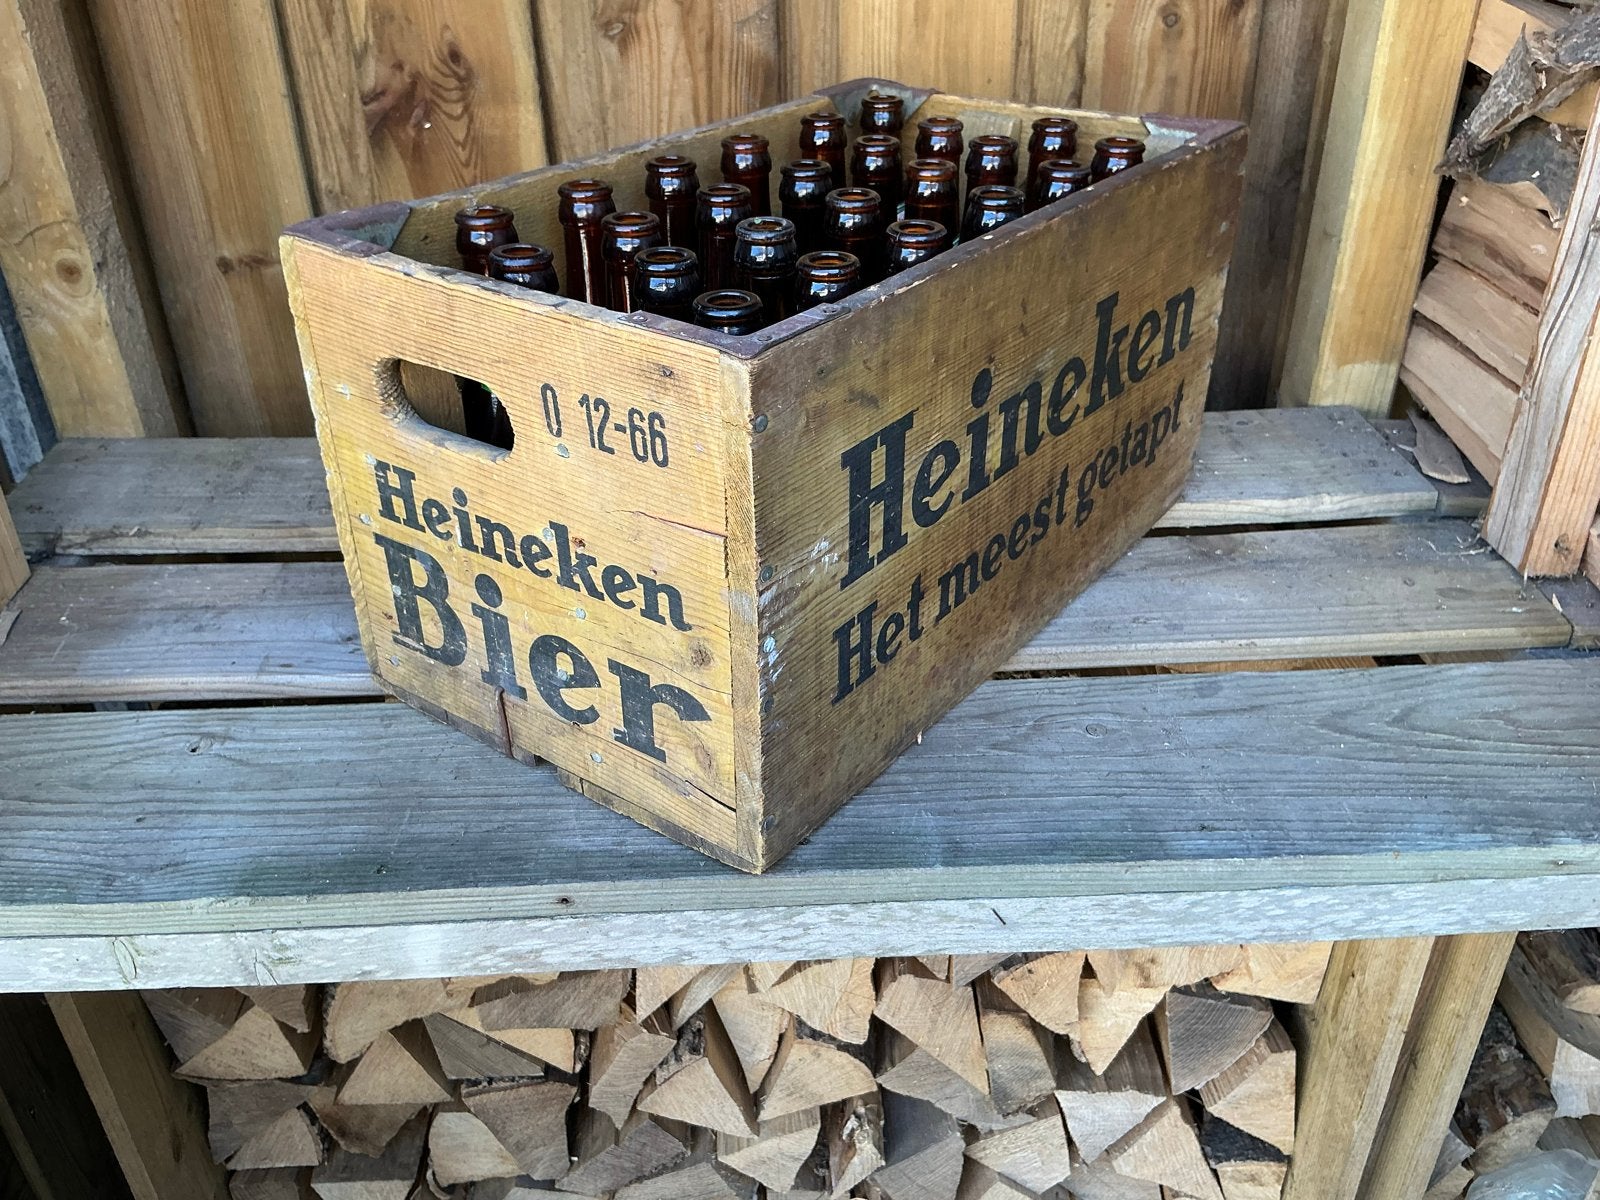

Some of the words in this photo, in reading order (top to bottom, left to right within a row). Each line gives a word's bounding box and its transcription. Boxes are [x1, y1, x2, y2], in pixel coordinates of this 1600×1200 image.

[374, 459, 693, 632] Heineken
[578, 393, 670, 468] 12-66
[832, 578, 925, 705] Het
[933, 462, 1070, 627] meest
[1073, 379, 1186, 529] getapt
[839, 286, 1195, 591] Heineken
[374, 533, 712, 764] Bier
